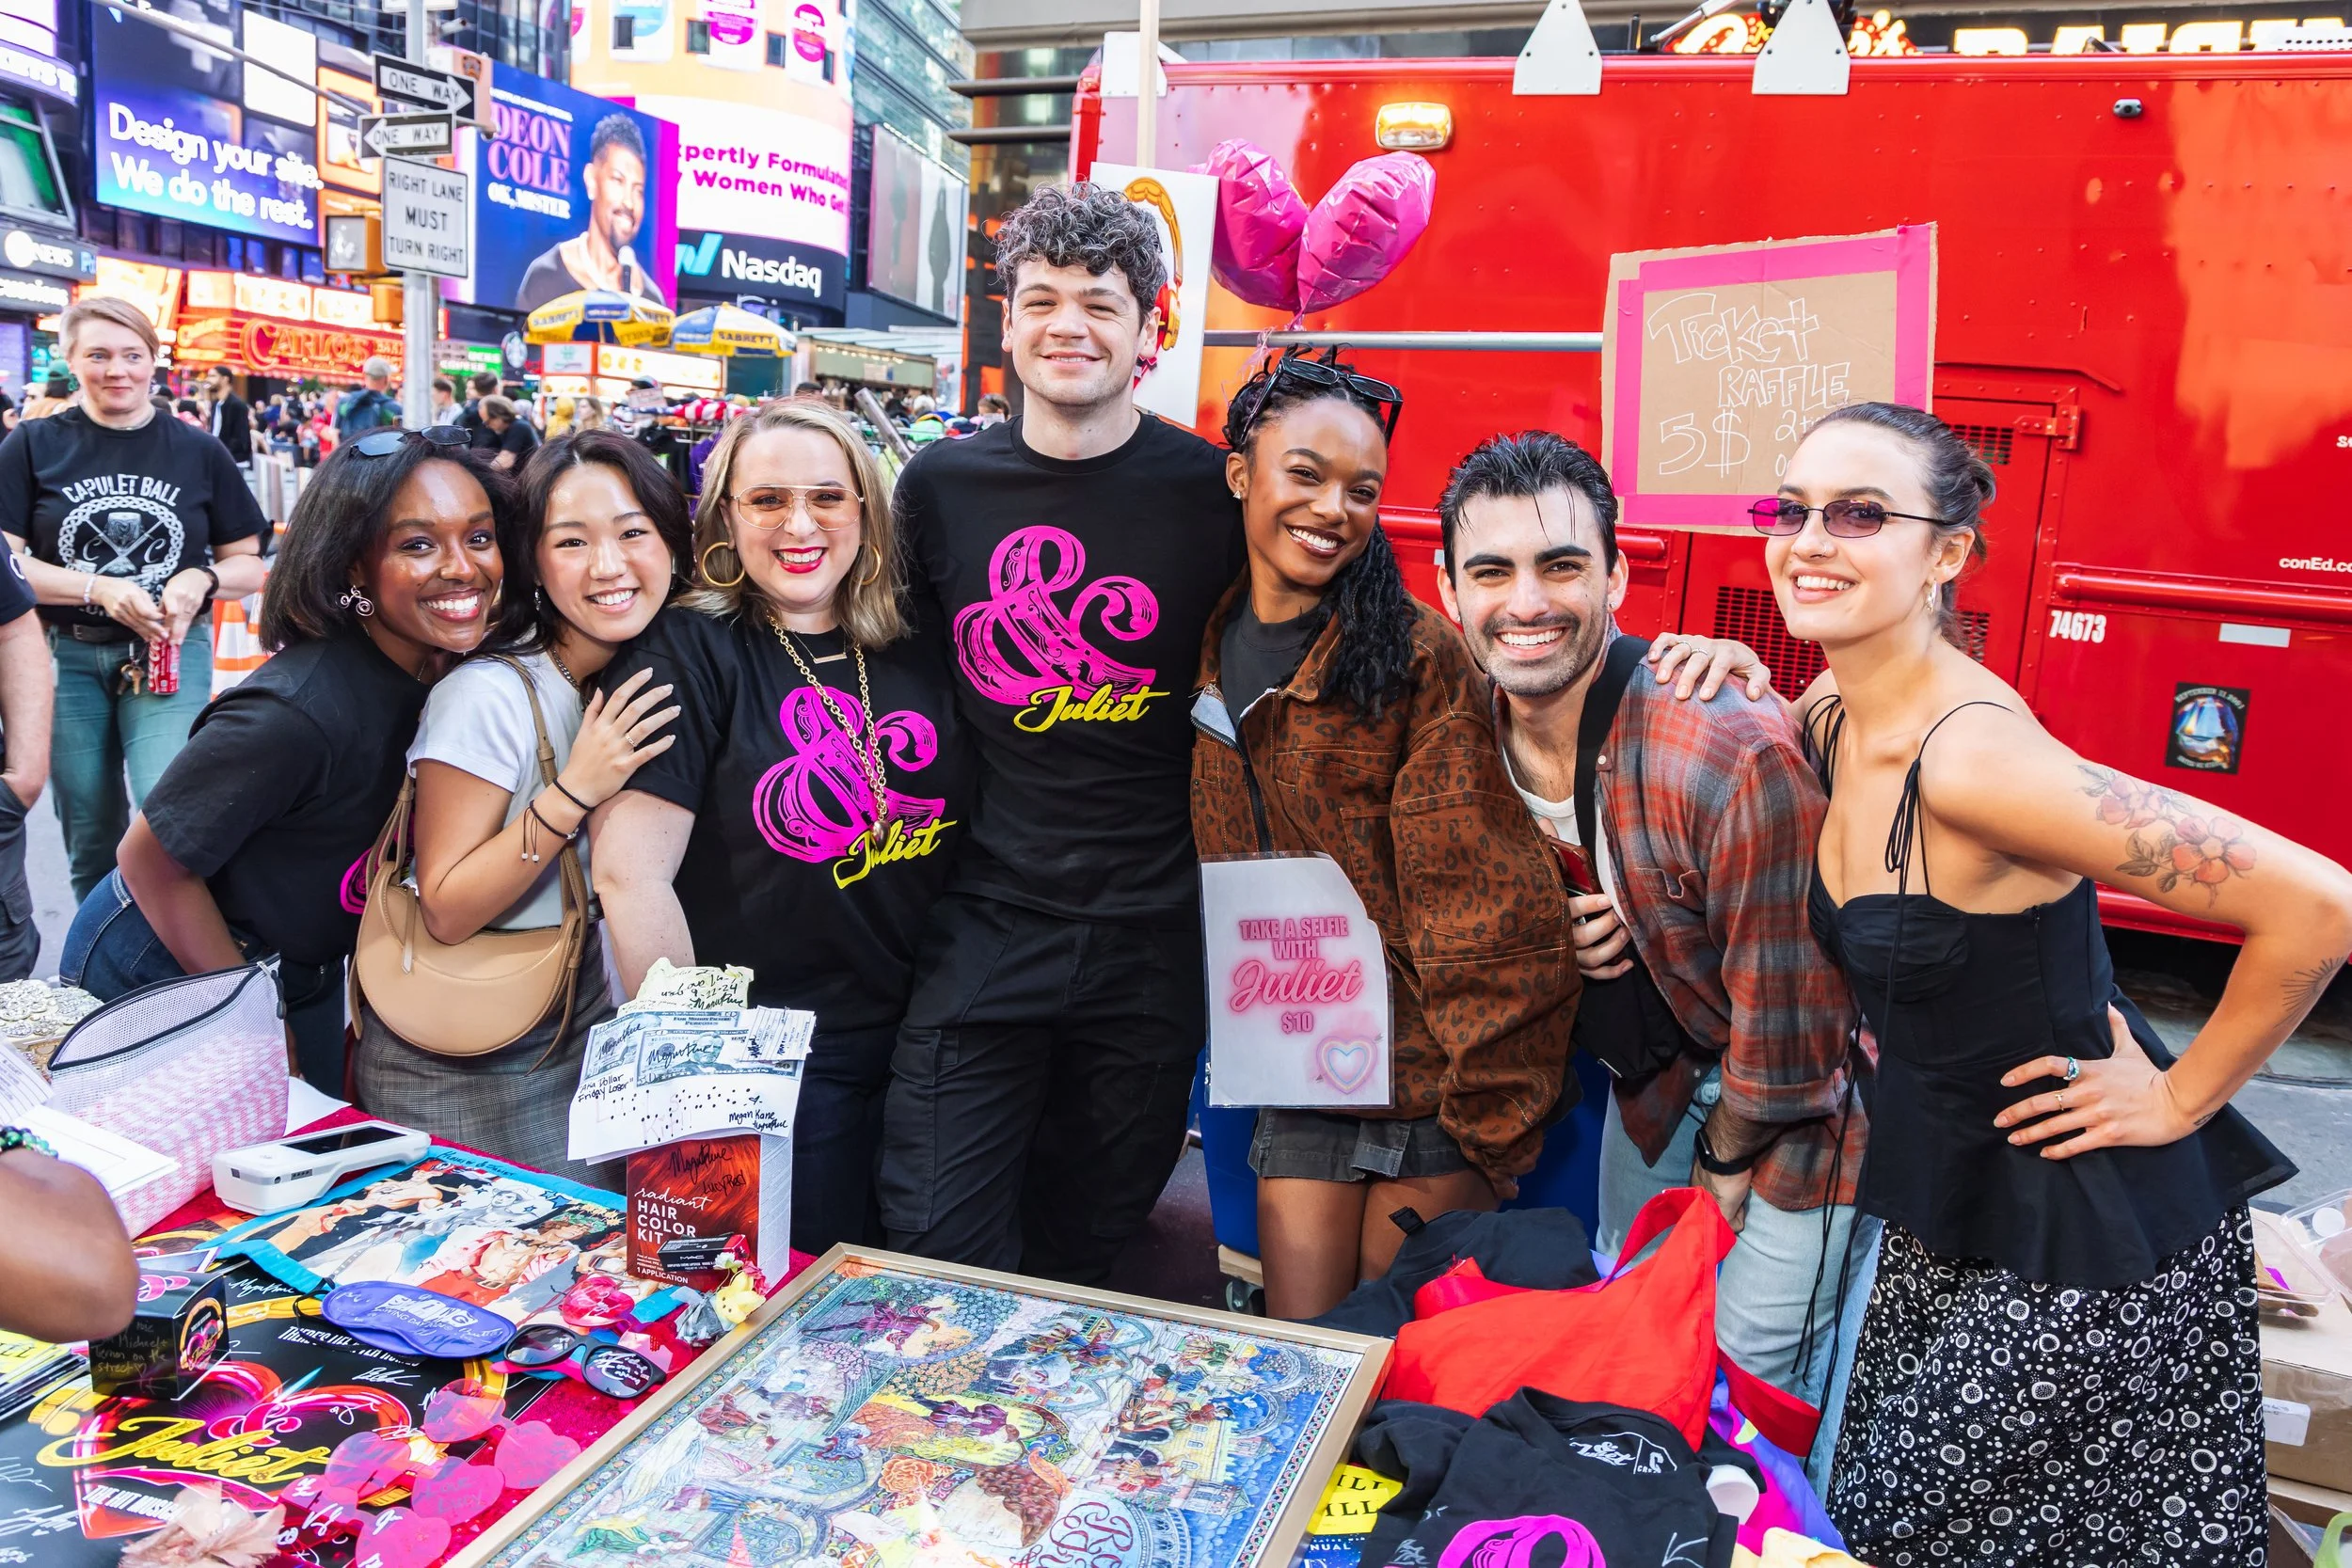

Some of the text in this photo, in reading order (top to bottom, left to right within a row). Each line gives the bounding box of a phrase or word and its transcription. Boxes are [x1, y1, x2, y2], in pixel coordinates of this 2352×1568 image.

[389, 72, 460, 107] ONE WAY
[108, 103, 324, 190] Design your site.
[373, 126, 441, 145] ONE WAY
[490, 102, 572, 159] DEON
[487, 141, 571, 196] COLE
[110, 151, 314, 230] We do the rest.
[389, 172, 464, 203] RIGHT LANE
[692, 169, 783, 197] Women
[789, 182, 827, 207] Who
[405, 206, 449, 230] MUST
[388, 236, 464, 263] TURN RIGHT
[721, 247, 823, 298] Nasdaq
[718, 330, 775, 345] SABRETT
[1718, 361, 1851, 411] RAFFLE
[1775, 409, 1798, 443] 2
[61, 473, 181, 507] CAPULET BALL
[2048, 610, 2107, 643] 74673
[1013, 683, 1171, 733] Juliet
[1239, 916, 1348, 940] TAKE A SELFIE
[1273, 939, 1318, 959] WITH
[1229, 958, 1365, 1013] Juliet
[1280, 1011, 1315, 1035] $10
[634, 1187, 713, 1212] radiant
[637, 1200, 677, 1221] HAIR
[637, 1214, 696, 1238] COLOR
[637, 1227, 664, 1244] KIT
[641, 1267, 689, 1284] APPLICATION
[36, 1417, 332, 1484] Juliet
[82, 1484, 120, 1505] THE
[104, 1490, 142, 1511] HIT
